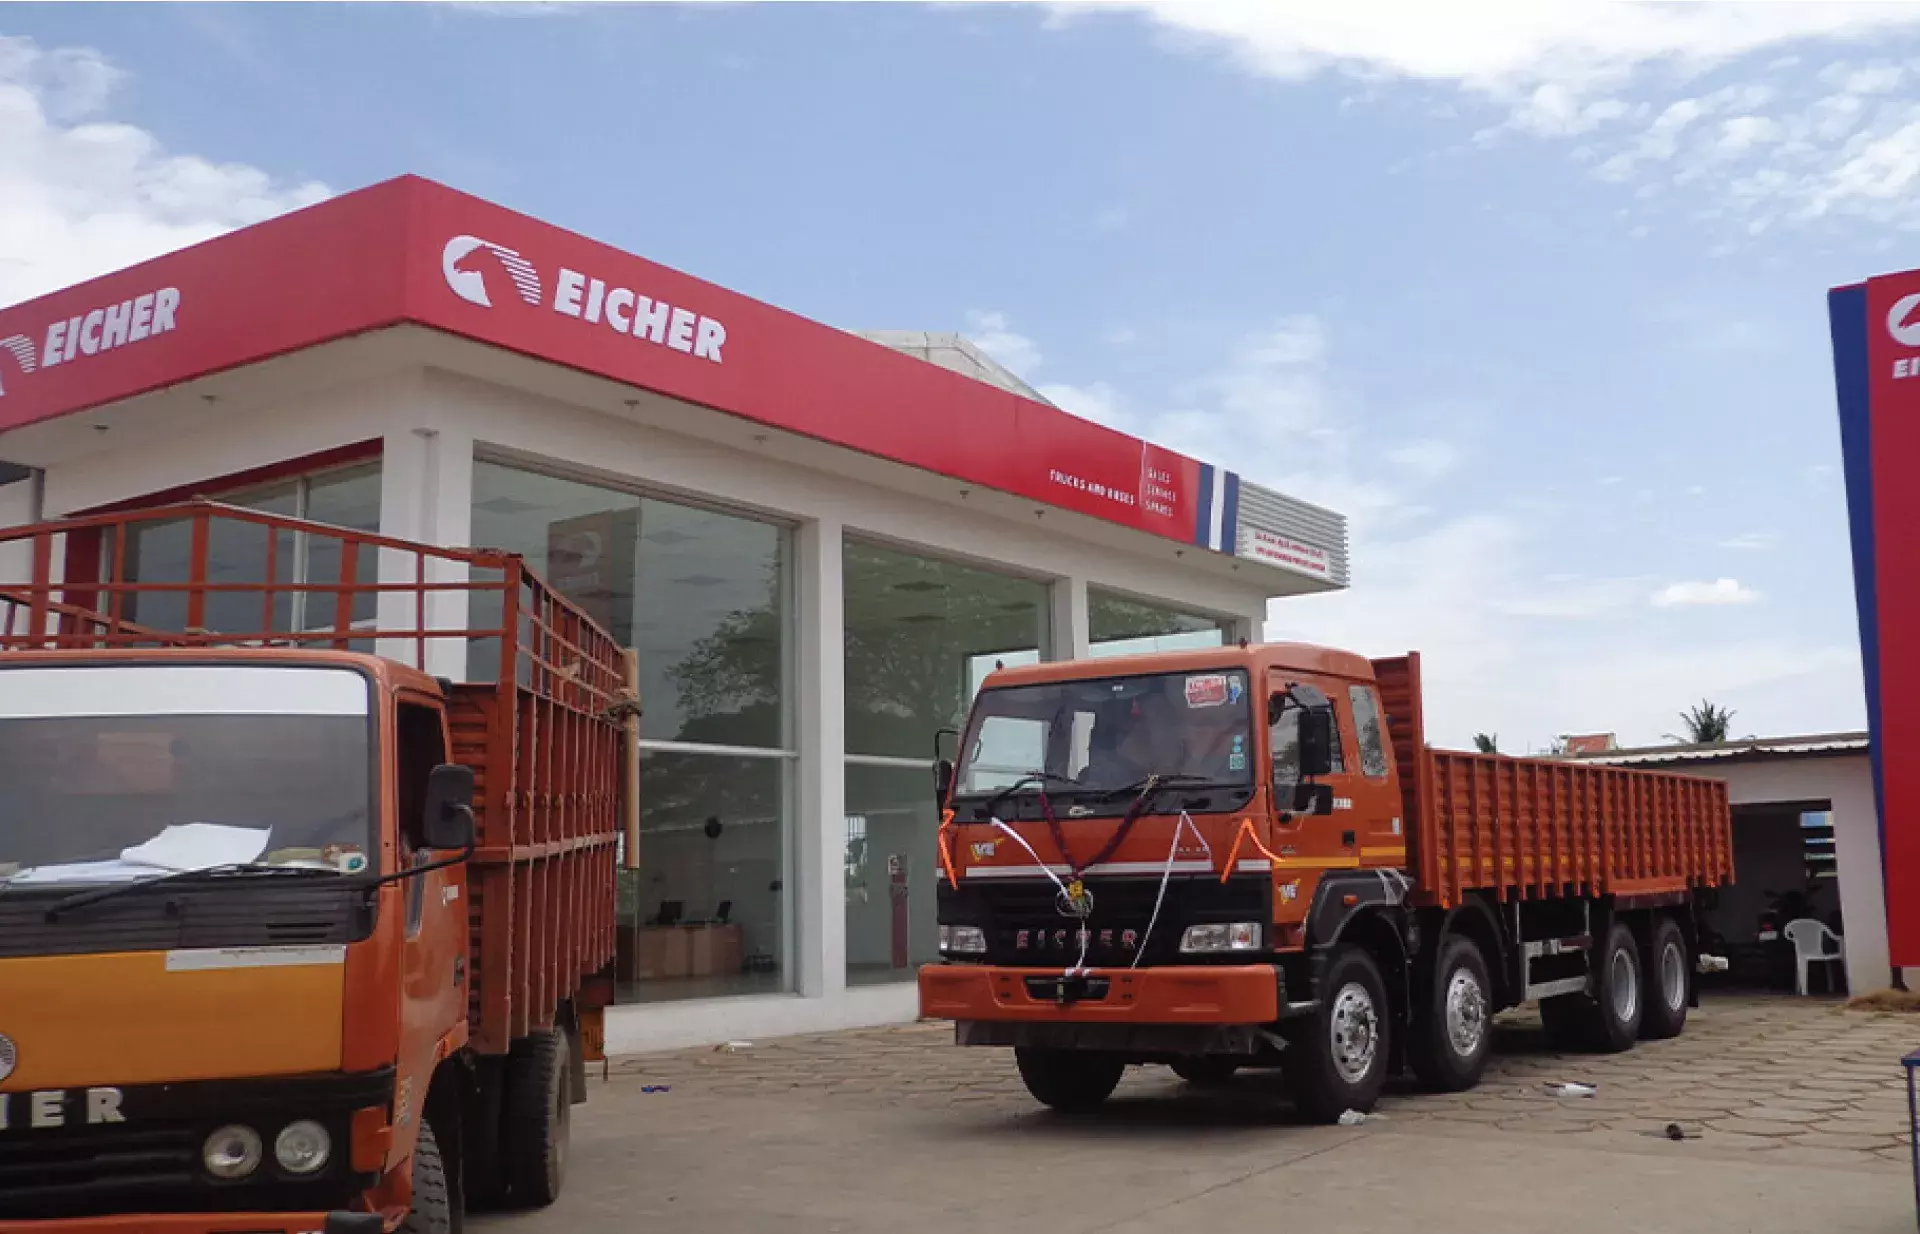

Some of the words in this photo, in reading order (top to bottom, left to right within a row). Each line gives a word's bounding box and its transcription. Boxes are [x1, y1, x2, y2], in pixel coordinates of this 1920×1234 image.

[41, 287, 181, 368] EICHER
[554, 268, 727, 363] EICHER
[1016, 928, 1138, 949] EICHER
[0, 1087, 127, 1130] ER
